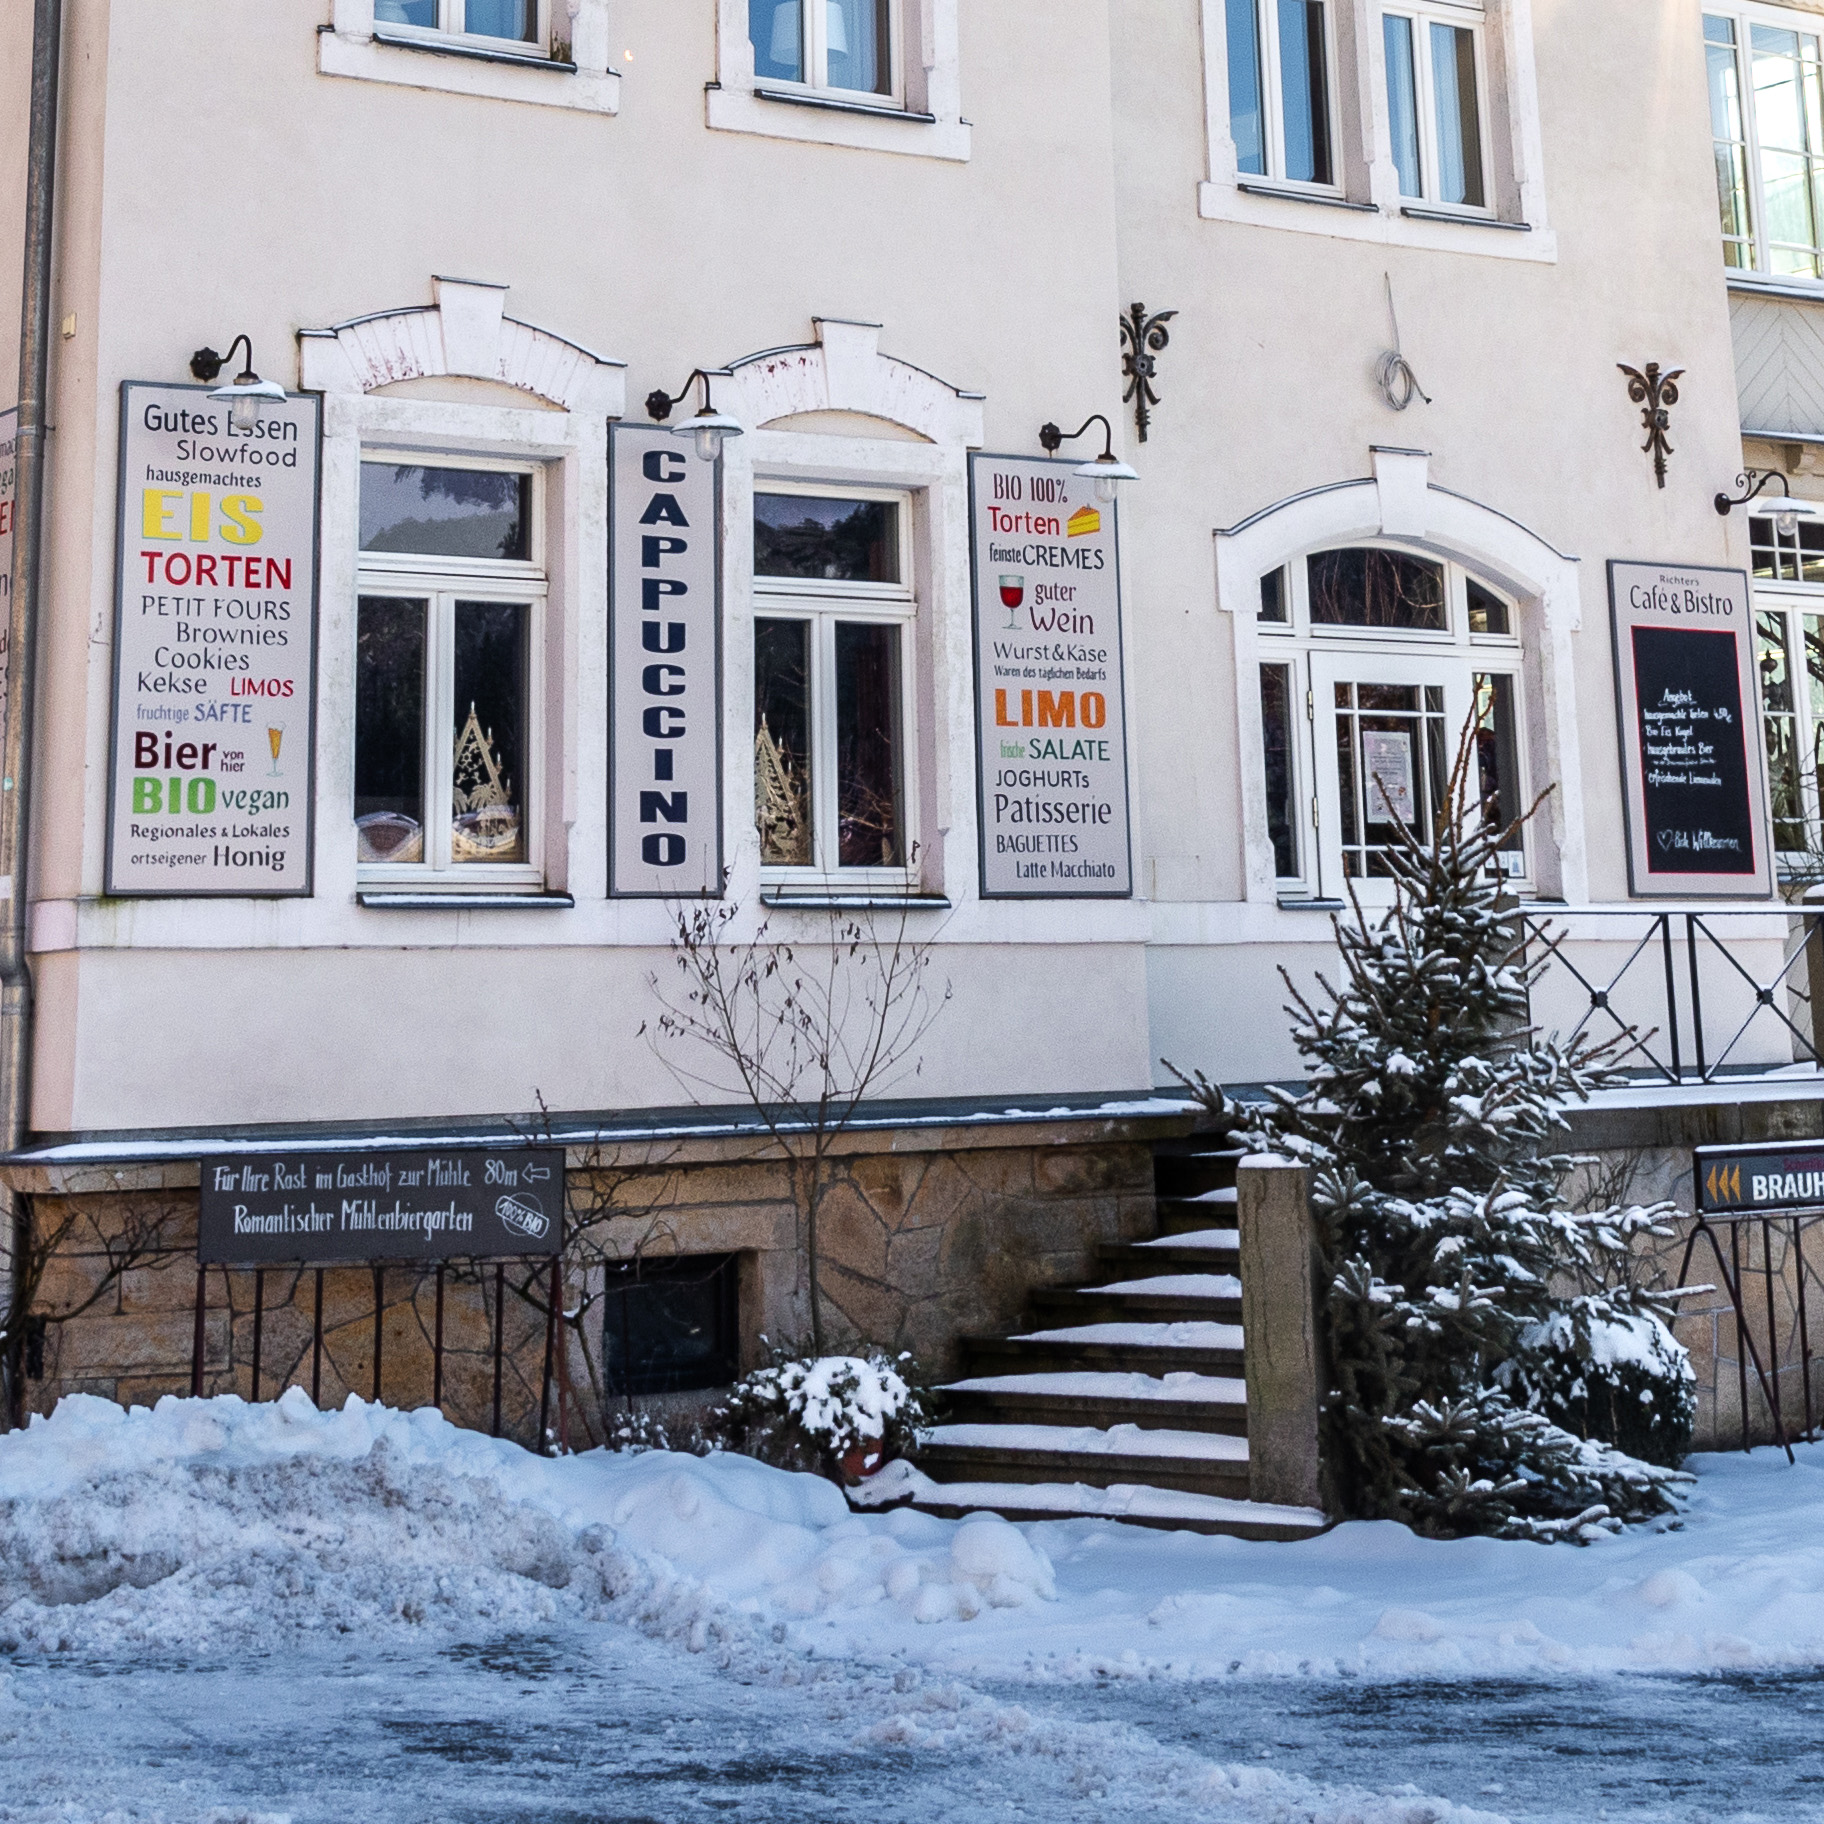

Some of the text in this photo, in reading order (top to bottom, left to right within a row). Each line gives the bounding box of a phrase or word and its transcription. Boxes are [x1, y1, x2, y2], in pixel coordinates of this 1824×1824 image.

[144, 404, 218, 435] Gutes
[177, 440, 296, 467] Slowfood
[147, 464, 262, 488] hausgemachtes
[994, 473, 1068, 503] BIO 100%
[142, 488, 263, 545] EIS
[987, 506, 1060, 536] Torten
[990, 543, 1104, 570] feinste CREMES
[141, 551, 291, 589] TORTEN
[1660, 575, 1699, 586] Richters
[1035, 583, 1076, 605] guter
[1630, 585, 1667, 611] Café
[1684, 590, 1732, 615] Bistro
[141, 595, 290, 620] PETIT FOURS
[1029, 606, 1094, 634] Wein
[177, 622, 288, 646] Brownies
[155, 647, 250, 670] Cookies
[639, 450, 689, 867] CAPPUCCINO
[138, 672, 294, 697] Kekse LIMOS
[994, 665, 1020, 676] Waren
[1023, 666, 1036, 678] des
[1077, 667, 1106, 680] Bedarfs
[137, 700, 253, 723] fruchtige SÄFTE
[995, 688, 1106, 729] LIMO
[135, 731, 244, 770] Bier von
[1029, 738, 1110, 761] SALATE
[221, 760, 245, 772] hier
[995, 770, 1090, 788] JOGHURTs
[132, 777, 289, 815] BIO vegan
[994, 794, 1111, 824] Patisserie
[130, 824, 290, 841] Regionales & Lokales
[997, 835, 1078, 853] BAGUETTES
[131, 845, 286, 871] ortseigener Honig
[1017, 859, 1115, 878] Latte Macchiato
[242, 1165, 269, 1191] Ihre
[273, 1162, 307, 1191] Rast
[316, 1165, 332, 1190] im
[337, 1162, 392, 1192] Gasthof
[398, 1169, 424, 1187] zur
[427, 1159, 472, 1187] Mühle
[233, 1199, 473, 1241] Romantischer Mühlenbiergarten
